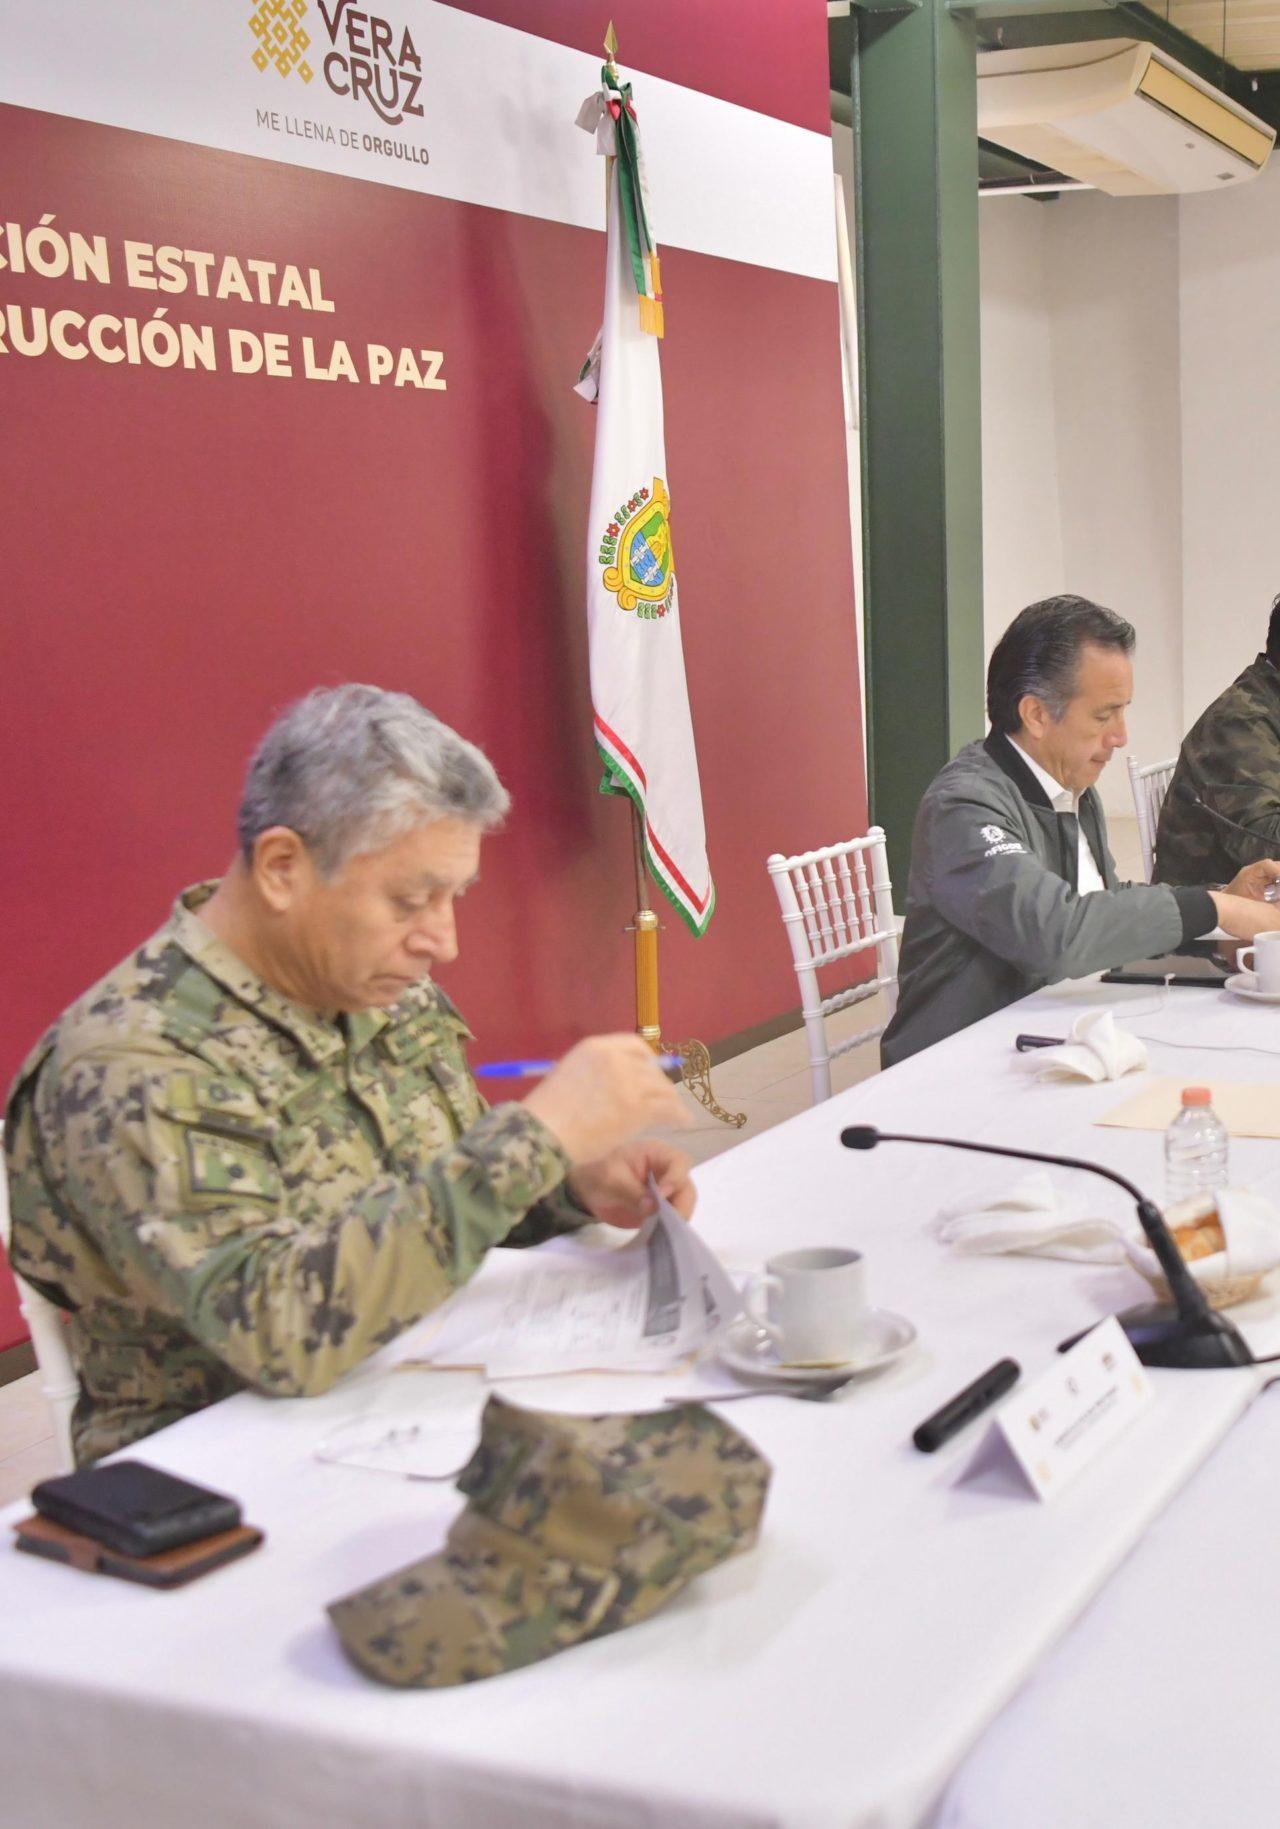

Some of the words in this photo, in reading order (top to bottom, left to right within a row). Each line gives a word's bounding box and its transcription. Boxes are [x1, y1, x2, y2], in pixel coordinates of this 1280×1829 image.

[317, 0, 422, 72] VERA
[323, 52, 425, 126] CRUZ
[256, 108, 281, 132] ME
[285, 116, 336, 145] LLENA
[339, 129, 360, 150] DE
[362, 134, 430, 166] ORGULLO
[0, 213, 111, 284] IÓN
[124, 240, 336, 313] ESTATAL
[0, 304, 217, 371] UCCIÓN
[228, 328, 293, 378] DE
[302, 336, 360, 384] LA
[367, 343, 447, 391] PAZ
